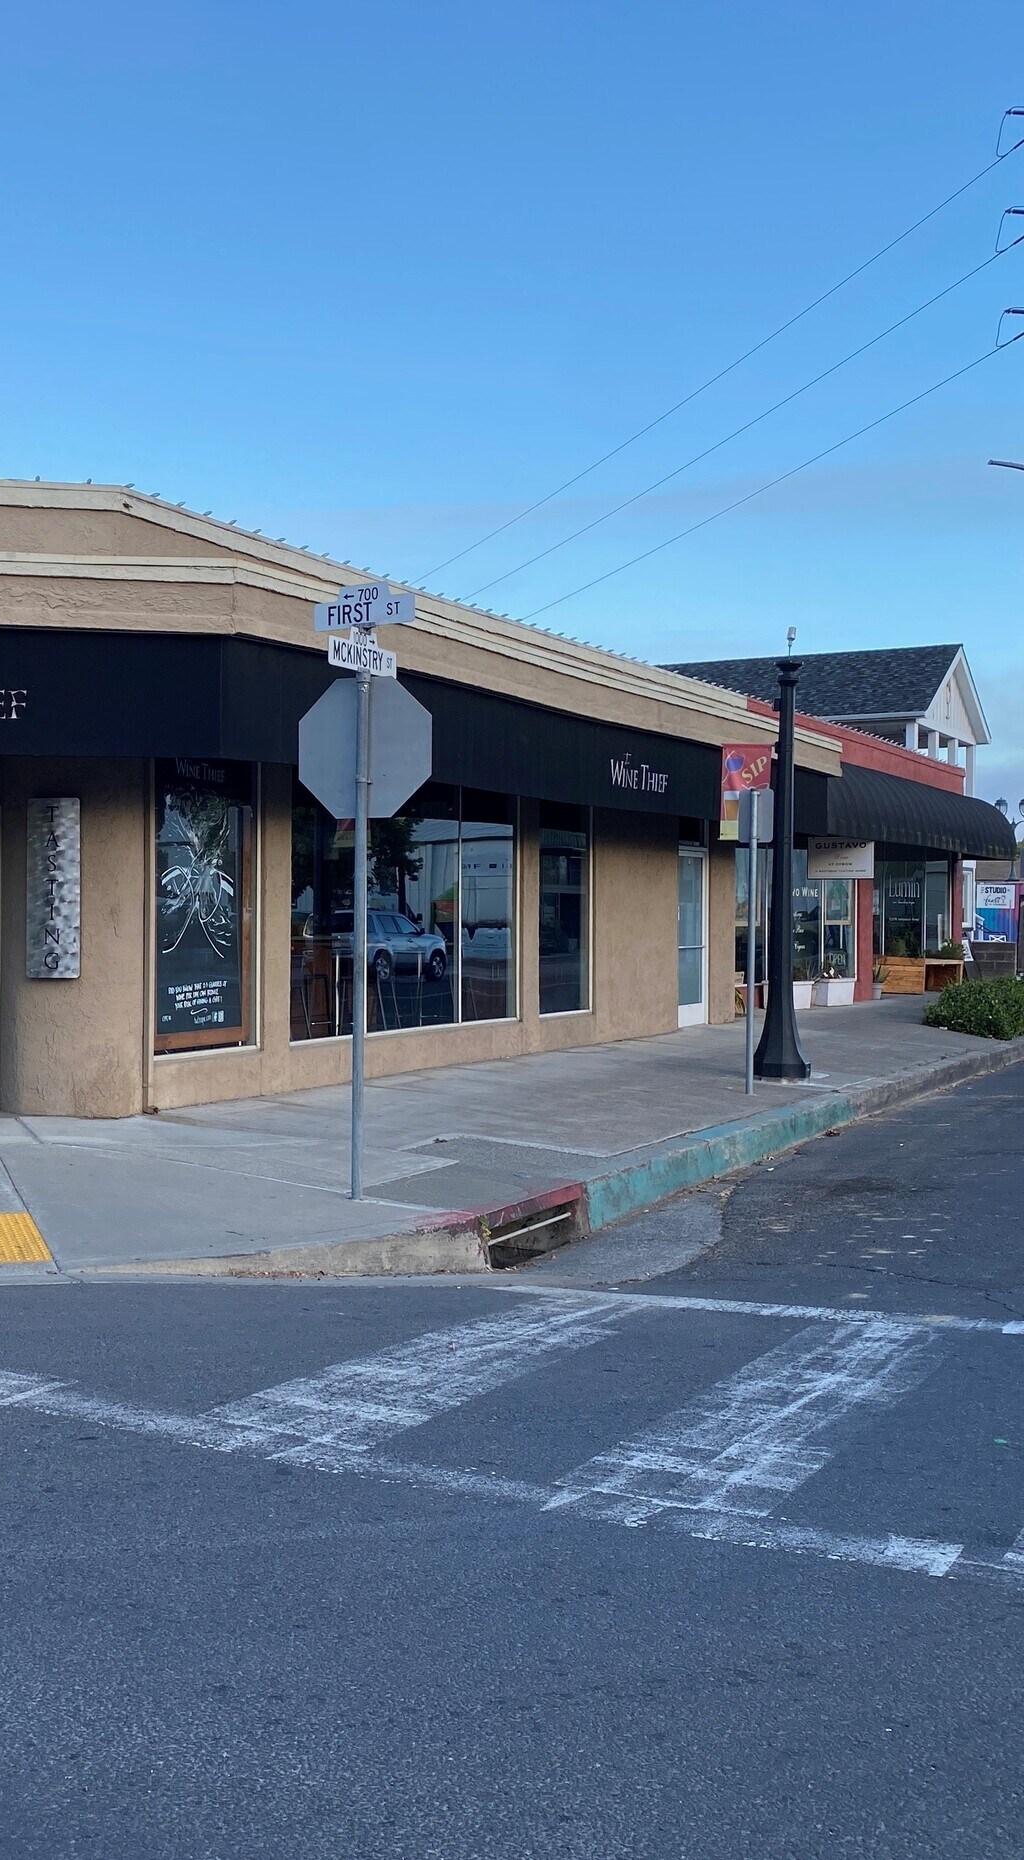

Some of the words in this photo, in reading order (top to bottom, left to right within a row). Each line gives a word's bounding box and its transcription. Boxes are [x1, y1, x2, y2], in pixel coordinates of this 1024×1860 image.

[358, 587, 378, 602] 700
[328, 601, 372, 626] FIRST
[386, 601, 400, 616] ST
[333, 640, 384, 671] MCKINSTRY
[176, 757, 200, 779] WINE
[200, 762, 225, 783] THIEF
[610, 758, 638, 790] WINE
[640, 764, 668, 793] THIEF
[742, 756, 768, 784] SIP
[44, 805, 60, 970] TASTING
[802, 886, 818, 898] WINE
[985, 886, 1007, 894] STUDIO
